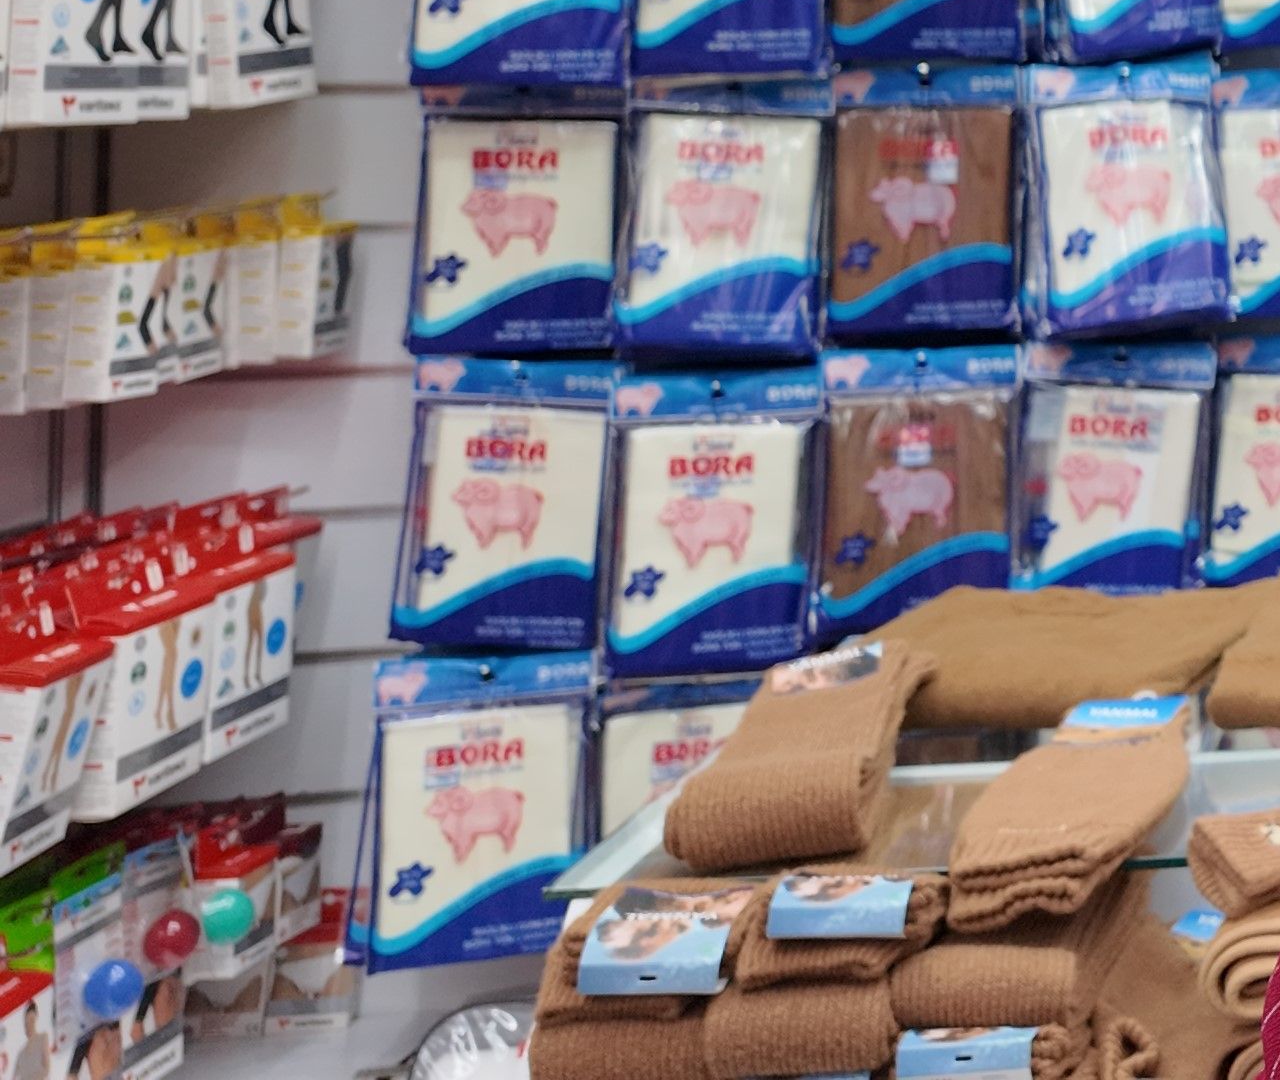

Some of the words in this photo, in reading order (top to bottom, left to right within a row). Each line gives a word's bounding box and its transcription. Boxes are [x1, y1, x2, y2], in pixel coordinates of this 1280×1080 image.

[1089, 125, 1166, 148] BORA
[472, 149, 557, 171] BORA
[678, 142, 763, 163] BORA
[1069, 415, 1148, 439] BORA
[466, 437, 546, 461] BORA
[669, 454, 753, 477] BORA
[436, 739, 523, 768] BORA
